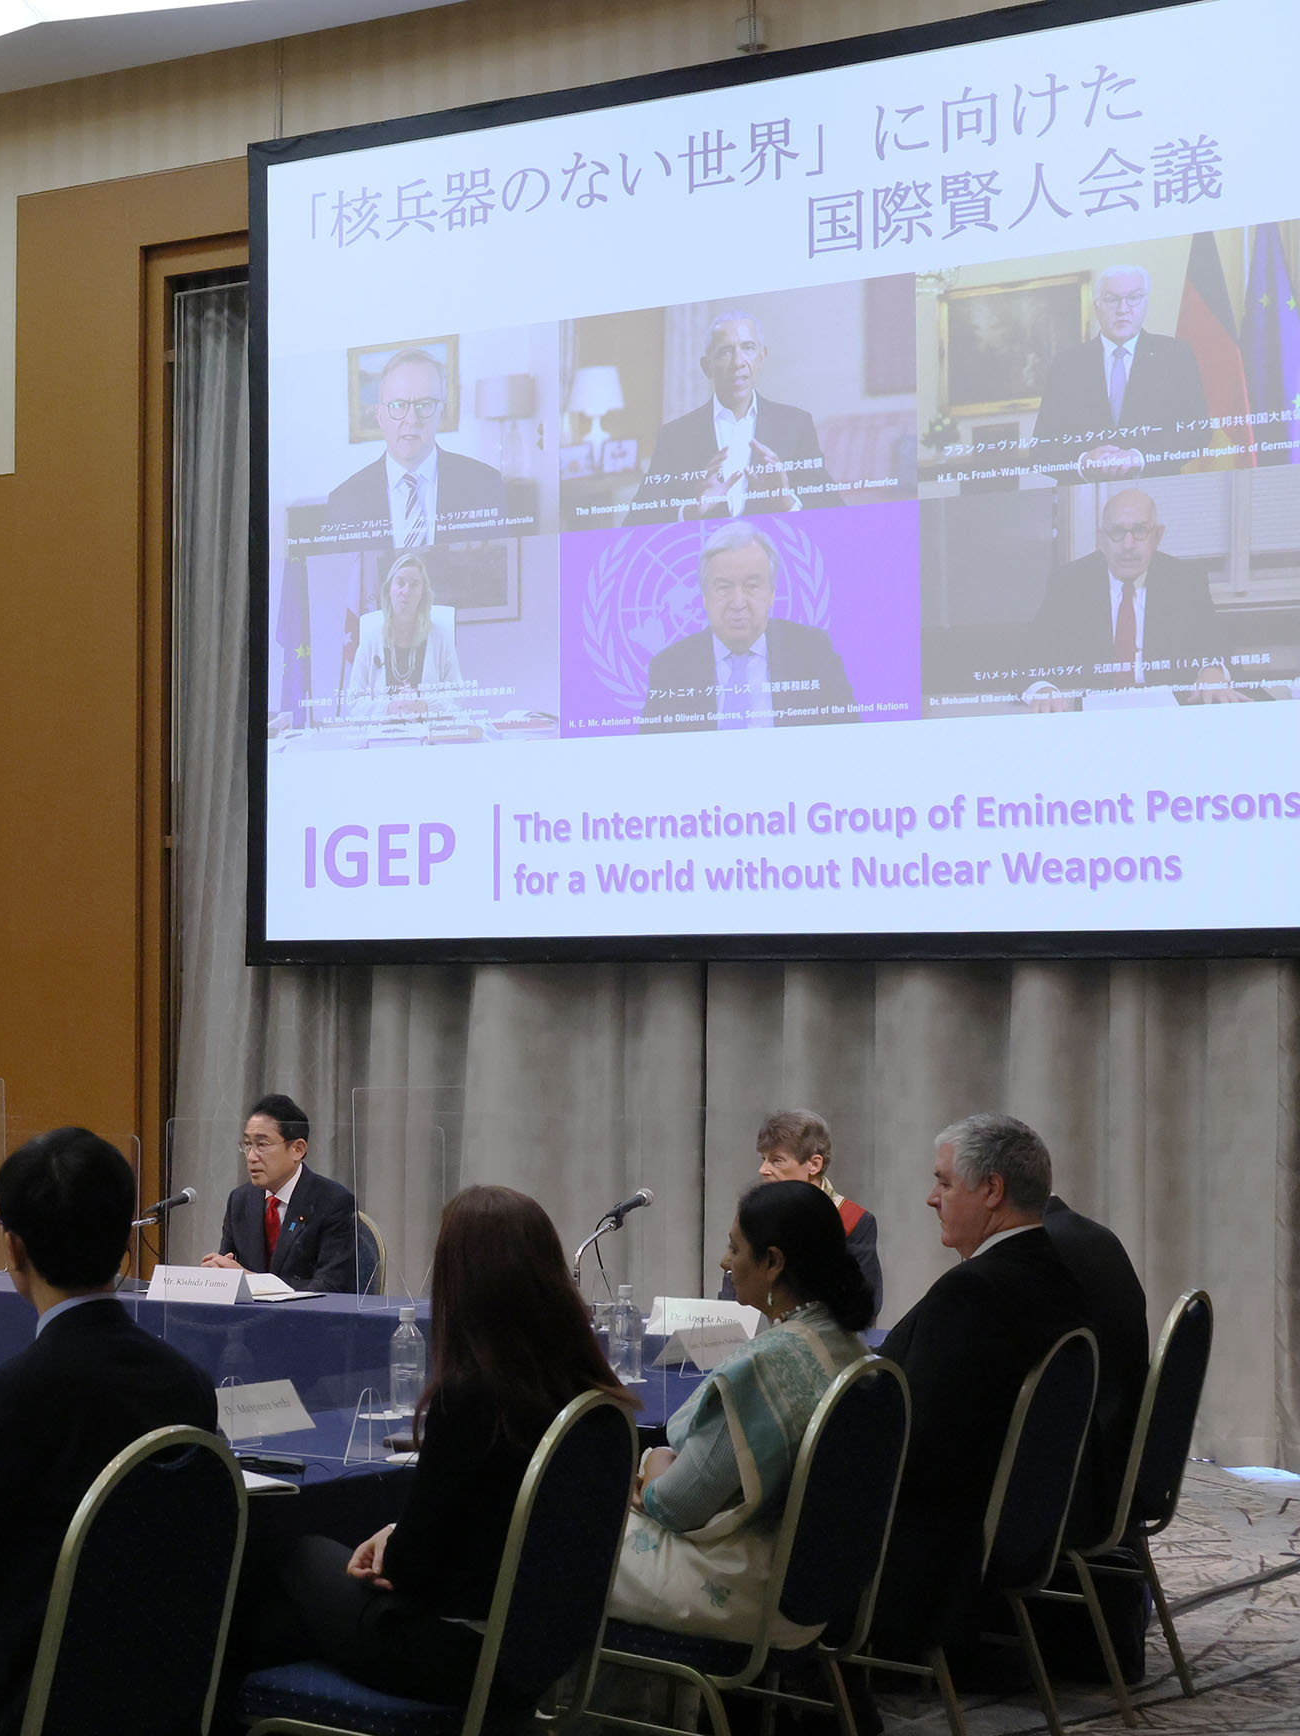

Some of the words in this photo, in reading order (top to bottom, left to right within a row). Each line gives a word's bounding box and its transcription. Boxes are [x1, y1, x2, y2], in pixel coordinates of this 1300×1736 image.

[310, 62, 1143, 249] 「核兵器のない世界」に向けた
[807, 135, 1224, 260] 国際賢人会議
[971, 467, 1030, 479] Frank-Walter
[1146, 453, 1161, 463] the
[1164, 448, 1200, 461] Federal
[1202, 444, 1245, 458] Republic
[1248, 442, 1258, 452] of
[1261, 439, 1300, 451] German
[576, 507, 589, 516] The
[591, 504, 629, 514] Honorable
[632, 500, 658, 511] Barack
[661, 499, 668, 507] H.
[670, 497, 699, 507] Obama,
[771, 489, 780, 497] of
[797, 483, 823, 495] United
[825, 481, 851, 492] States
[854, 479, 862, 489] of
[864, 477, 898, 488] America
[1230, 680, 1259, 689] Energy
[633, 714, 661, 725] Manuel
[663, 714, 673, 723] de
[675, 712, 704, 722] Oliveira
[821, 705, 829, 714] of
[832, 705, 845, 714] the
[847, 703, 874, 713] United
[877, 702, 908, 711] Nations
[513, 811, 571, 844] The
[582, 801, 796, 841] International
[806, 801, 917, 839] Group
[927, 794, 966, 831] of
[976, 792, 1134, 828] Eminent
[1146, 788, 1300, 823] Persons
[303, 822, 456, 889] IGEP
[513, 863, 559, 896] for
[567, 871, 586, 895] a
[595, 858, 695, 894] World
[704, 856, 841, 891] without
[851, 852, 992, 888] Nuclear
[1001, 851, 1183, 891] Weapons
[176, 1278, 203, 1287] Kishida
[204, 1279, 228, 1288] Fumio
